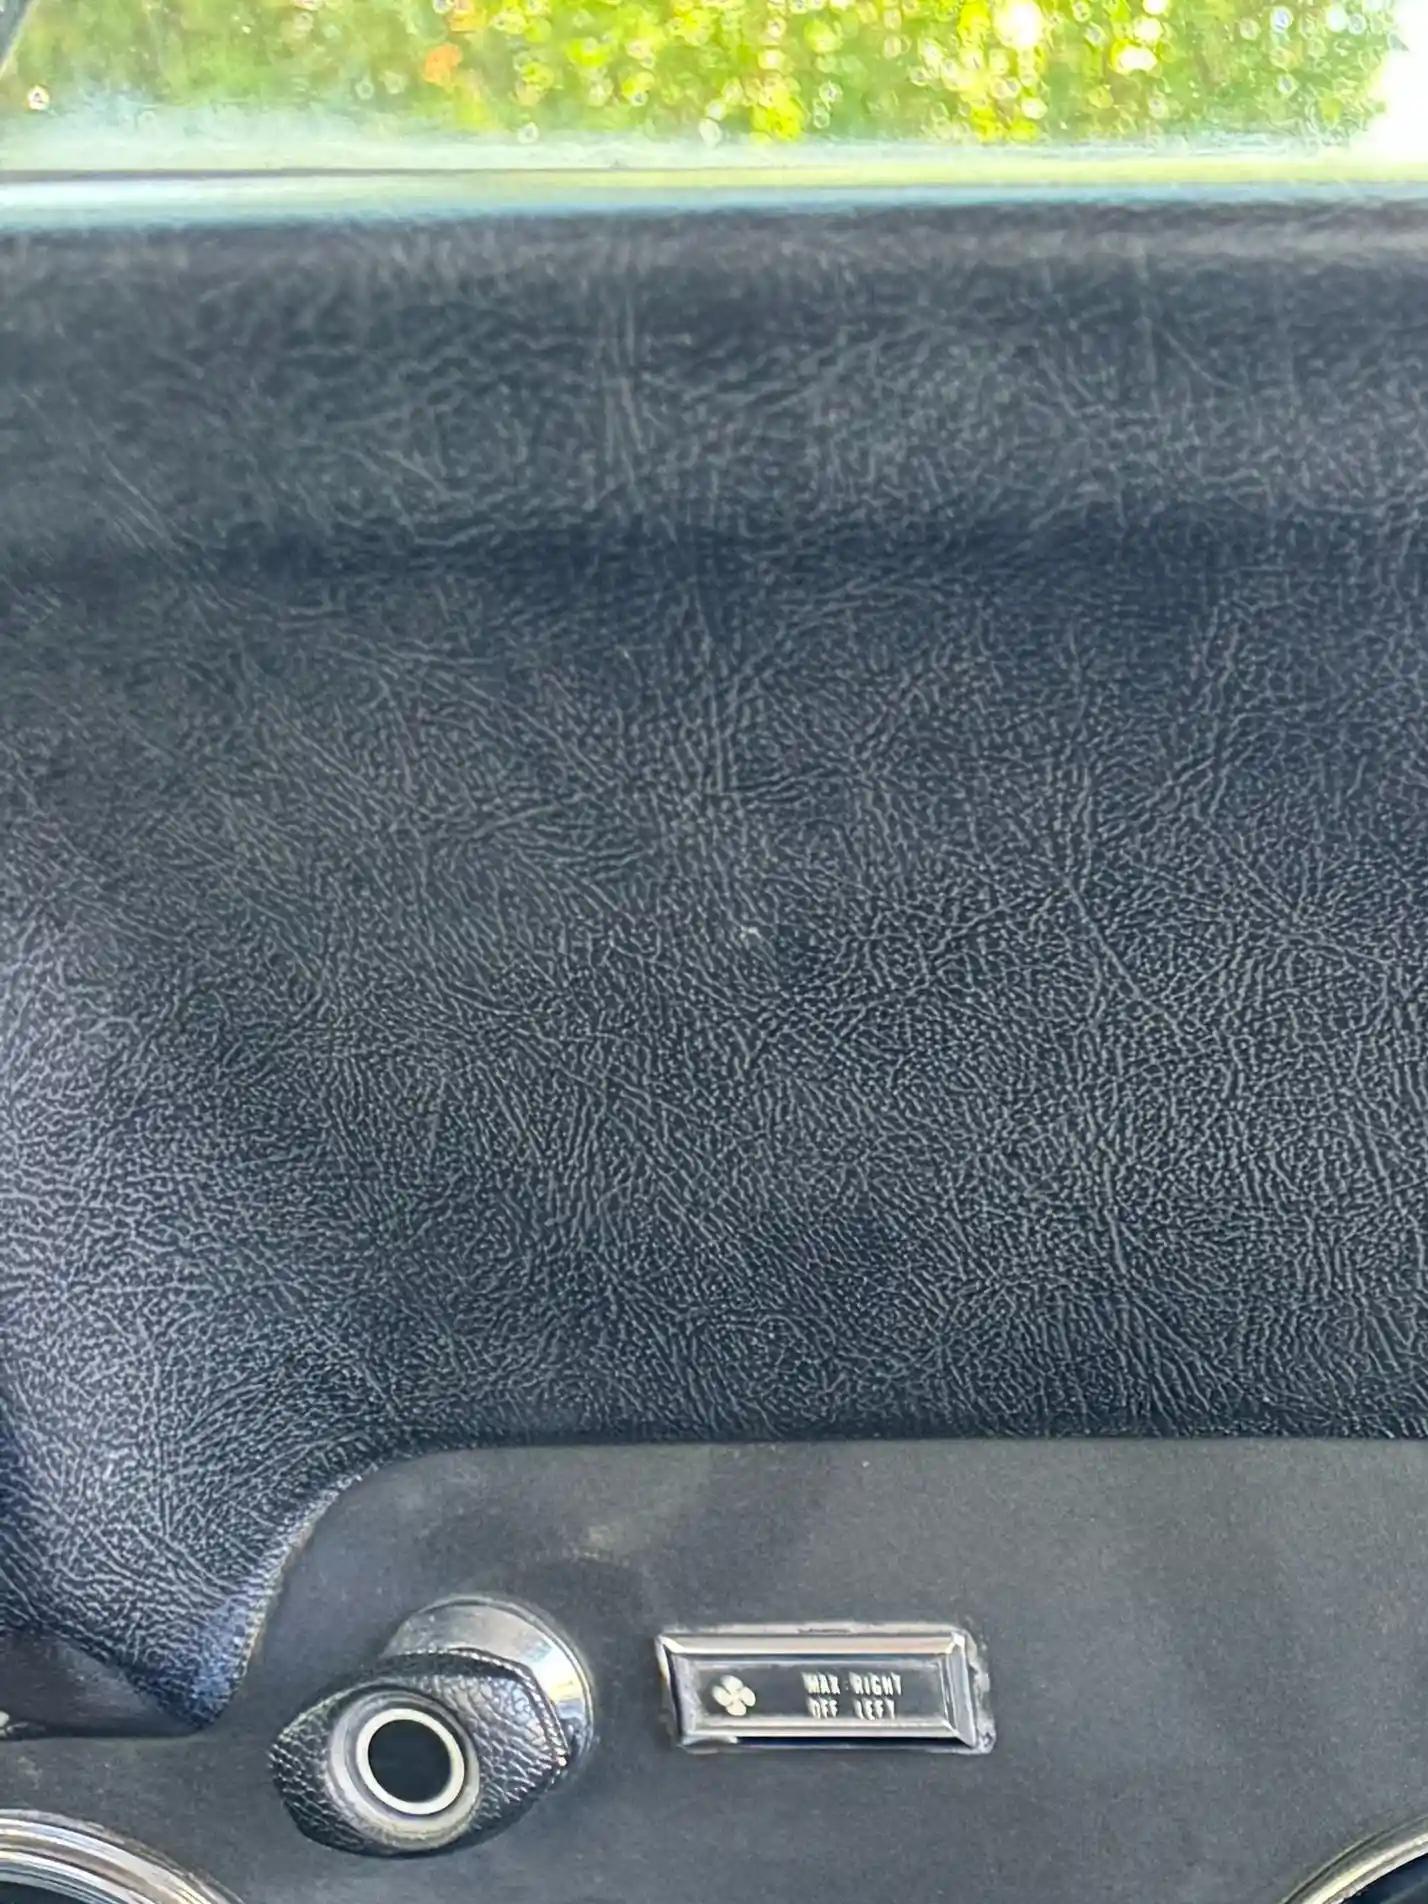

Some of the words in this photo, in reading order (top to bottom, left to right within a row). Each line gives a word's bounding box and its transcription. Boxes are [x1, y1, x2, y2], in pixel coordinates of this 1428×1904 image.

[801, 1672, 840, 1695] MAX
[850, 1672, 901, 1695] RIGHT
[804, 1699, 838, 1719] OFF
[850, 1699, 896, 1720] LEFT
